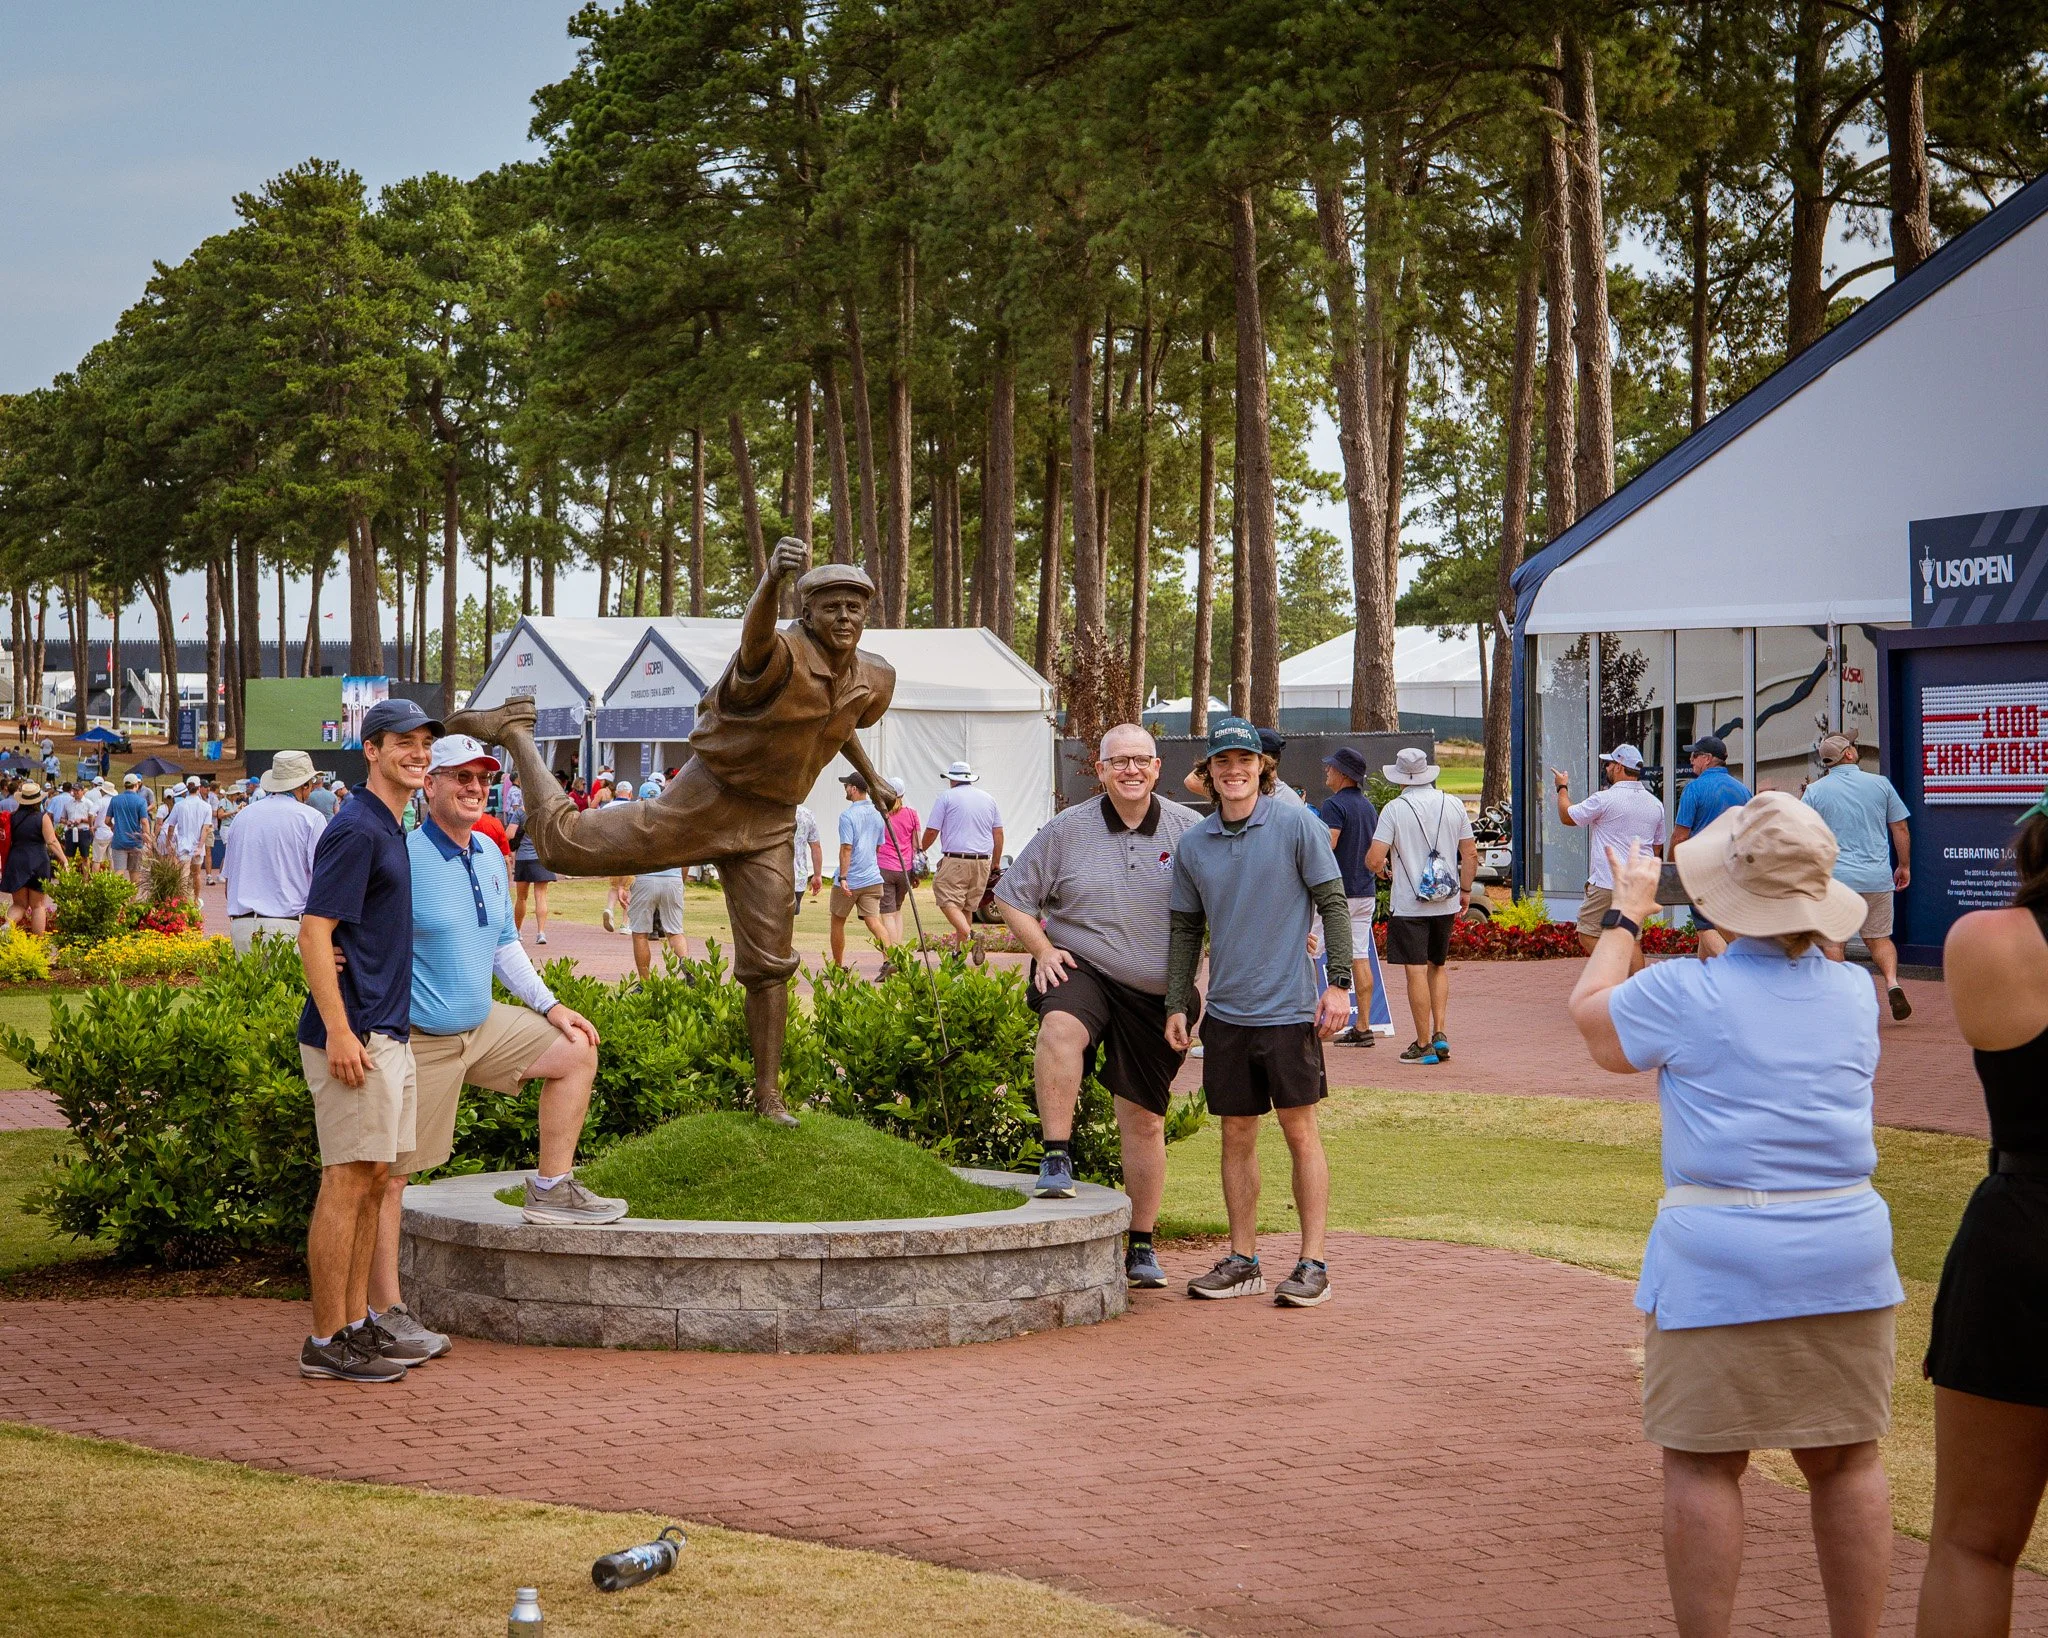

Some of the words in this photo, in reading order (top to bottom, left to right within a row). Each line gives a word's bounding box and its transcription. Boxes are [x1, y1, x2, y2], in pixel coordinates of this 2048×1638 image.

[1936, 554, 2013, 589] USOPEN
[1983, 706, 2038, 738] 1000
[1943, 847, 1999, 858] CELEBRATING
